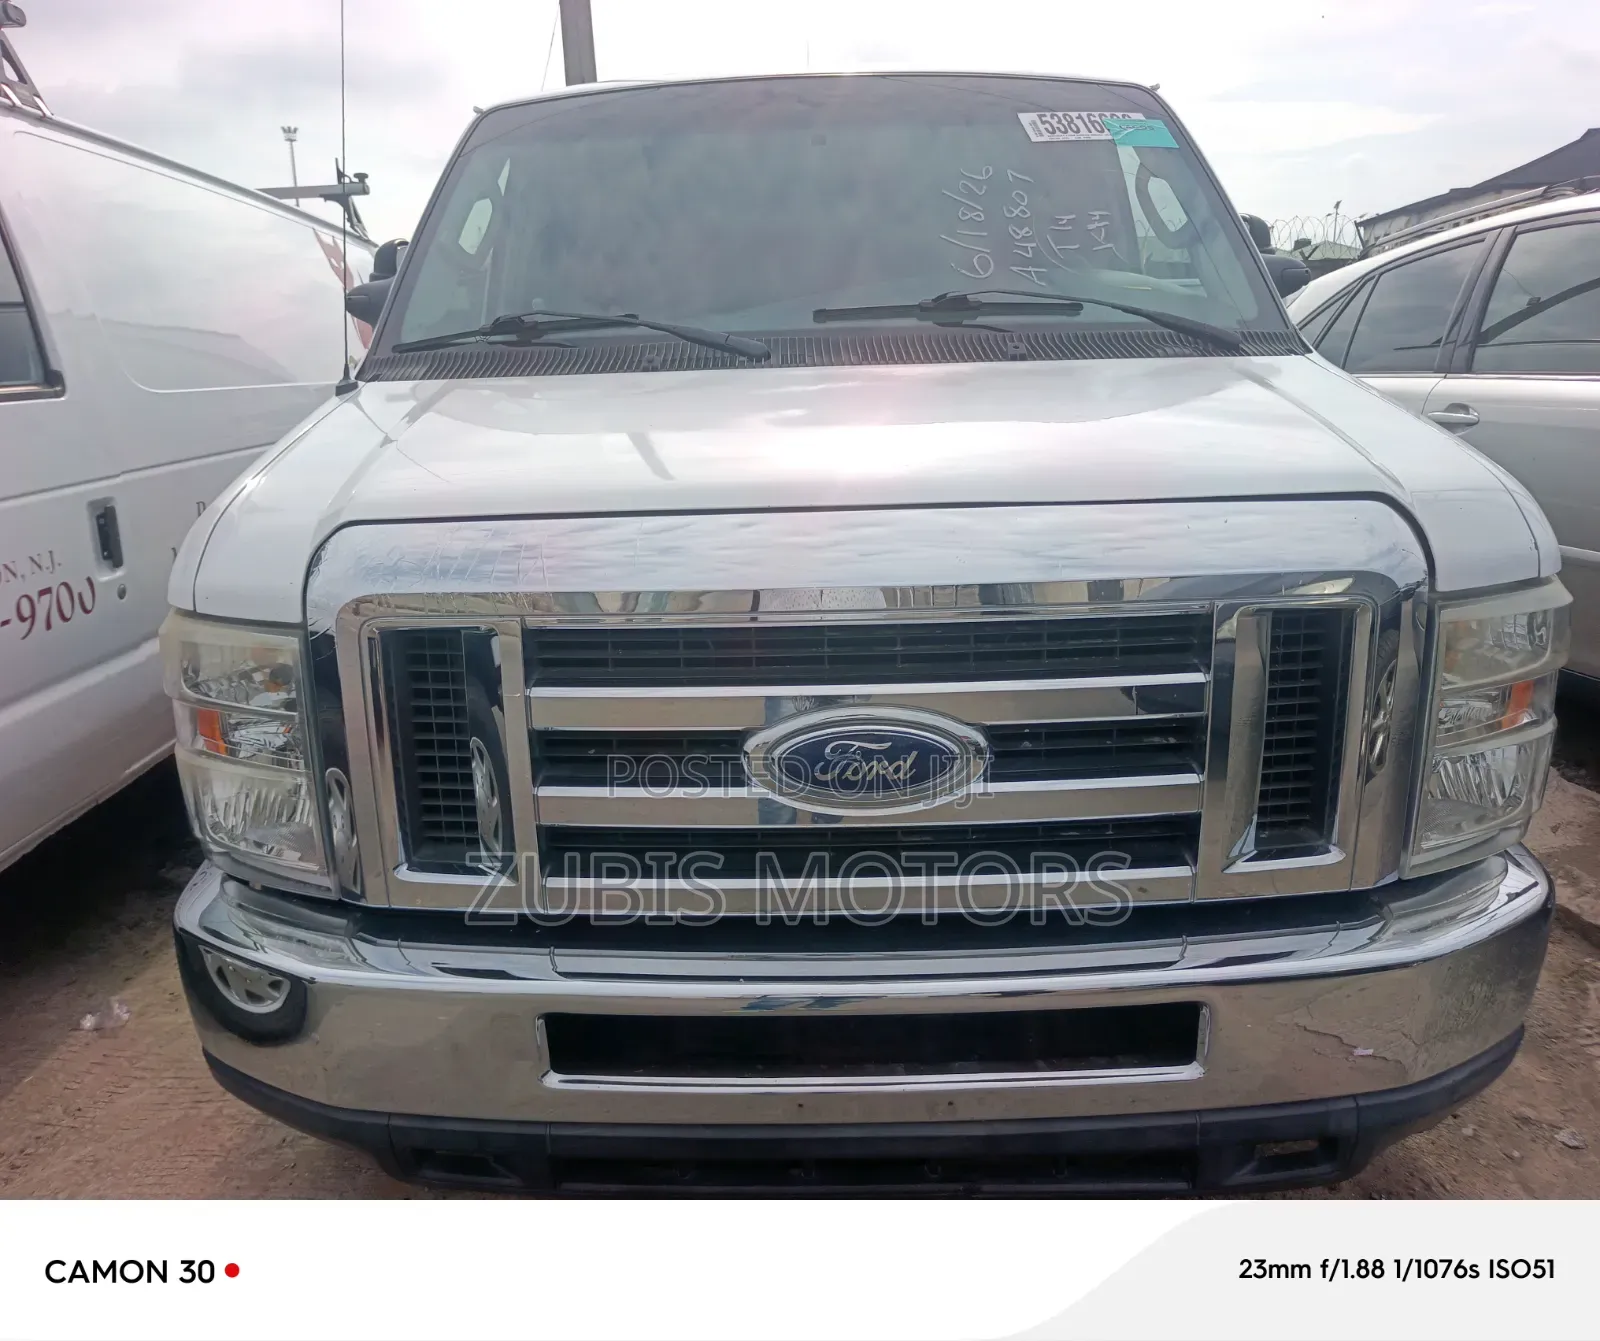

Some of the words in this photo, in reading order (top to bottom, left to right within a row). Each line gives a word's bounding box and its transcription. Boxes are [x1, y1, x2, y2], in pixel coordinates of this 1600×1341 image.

[1036, 112, 1132, 135] 53816
[940, 164, 994, 279] 6/18/26
[814, 740, 917, 782] Ford
